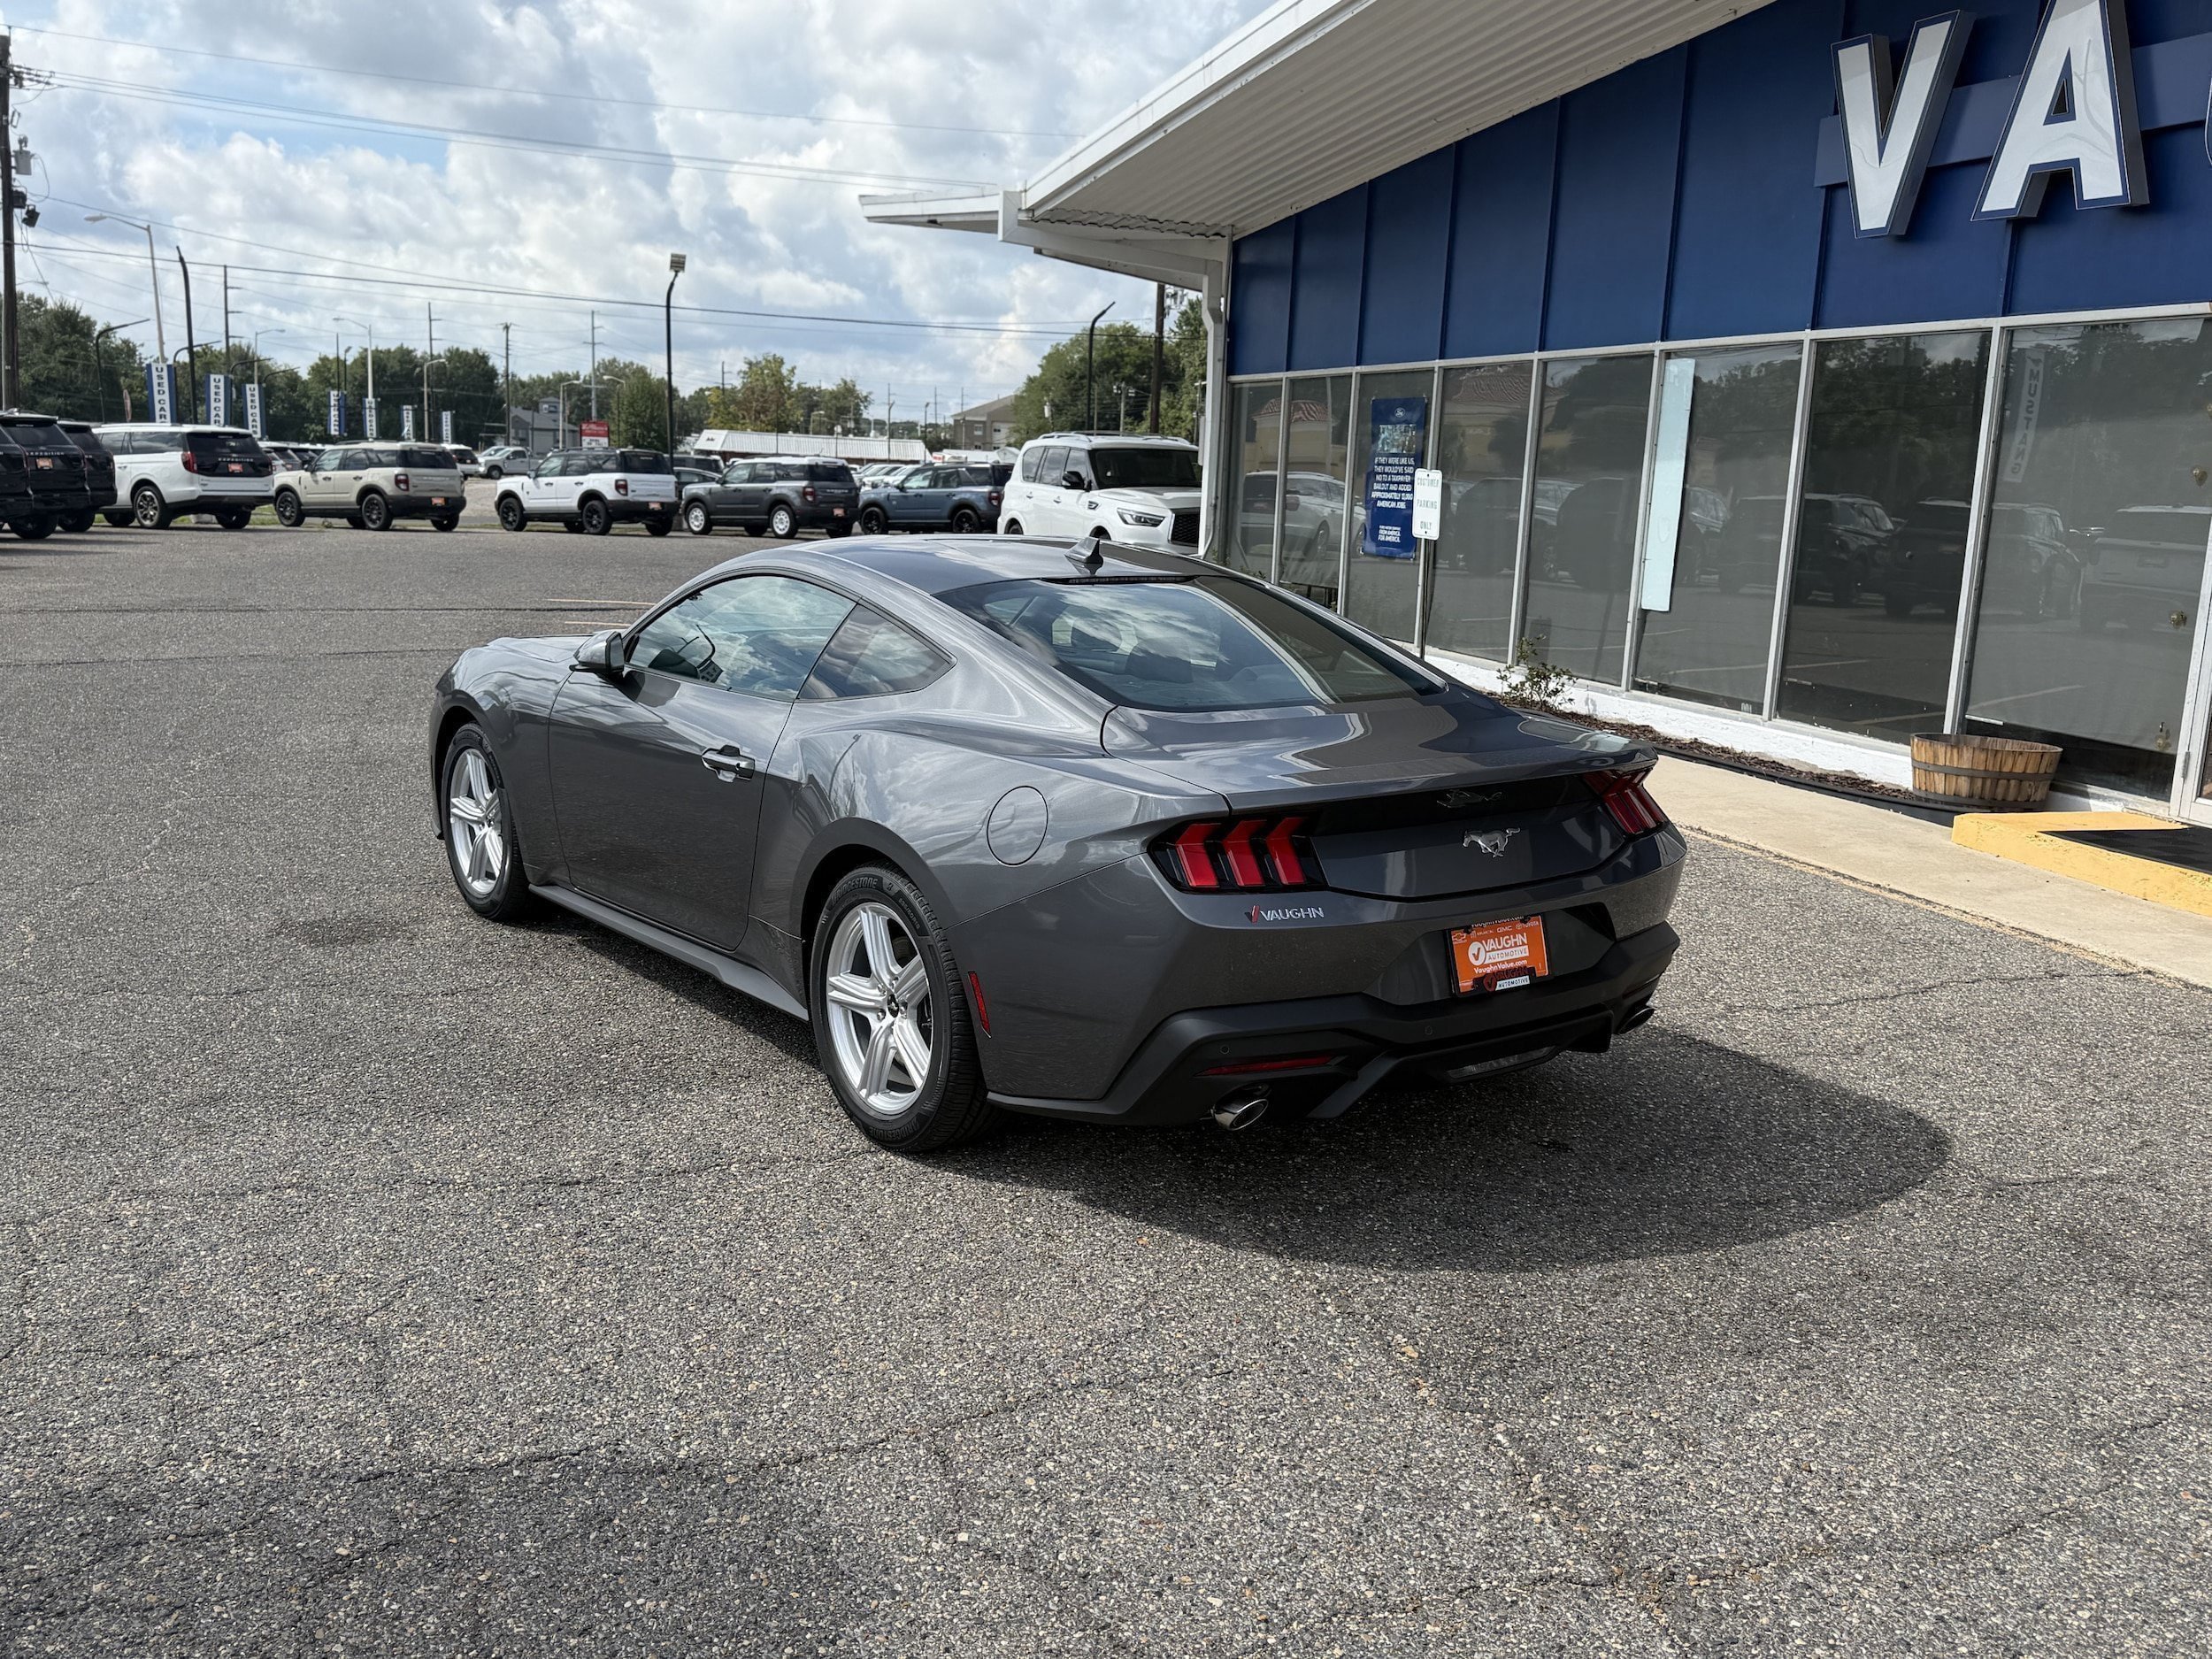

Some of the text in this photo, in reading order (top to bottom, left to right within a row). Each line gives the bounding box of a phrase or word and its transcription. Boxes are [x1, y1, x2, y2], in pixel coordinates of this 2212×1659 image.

[1831, 0, 2212, 239] VA
[155, 366, 167, 423] USED CAR
[213, 378, 222, 403] USED
[249, 387, 257, 410] USED
[1417, 478, 1439, 488] CUSTOMER
[1417, 499, 1438, 510] PARKING
[1420, 521, 1432, 530] ONLY
[1260, 907, 1325, 921] VAUGHN
[1482, 933, 1528, 951] VAUGHN
[1487, 948, 1528, 961] AUTOMOTIVE
[1474, 959, 1528, 974] VaughnValue.com
[1498, 977, 1529, 989] AUTOMOTIVE
